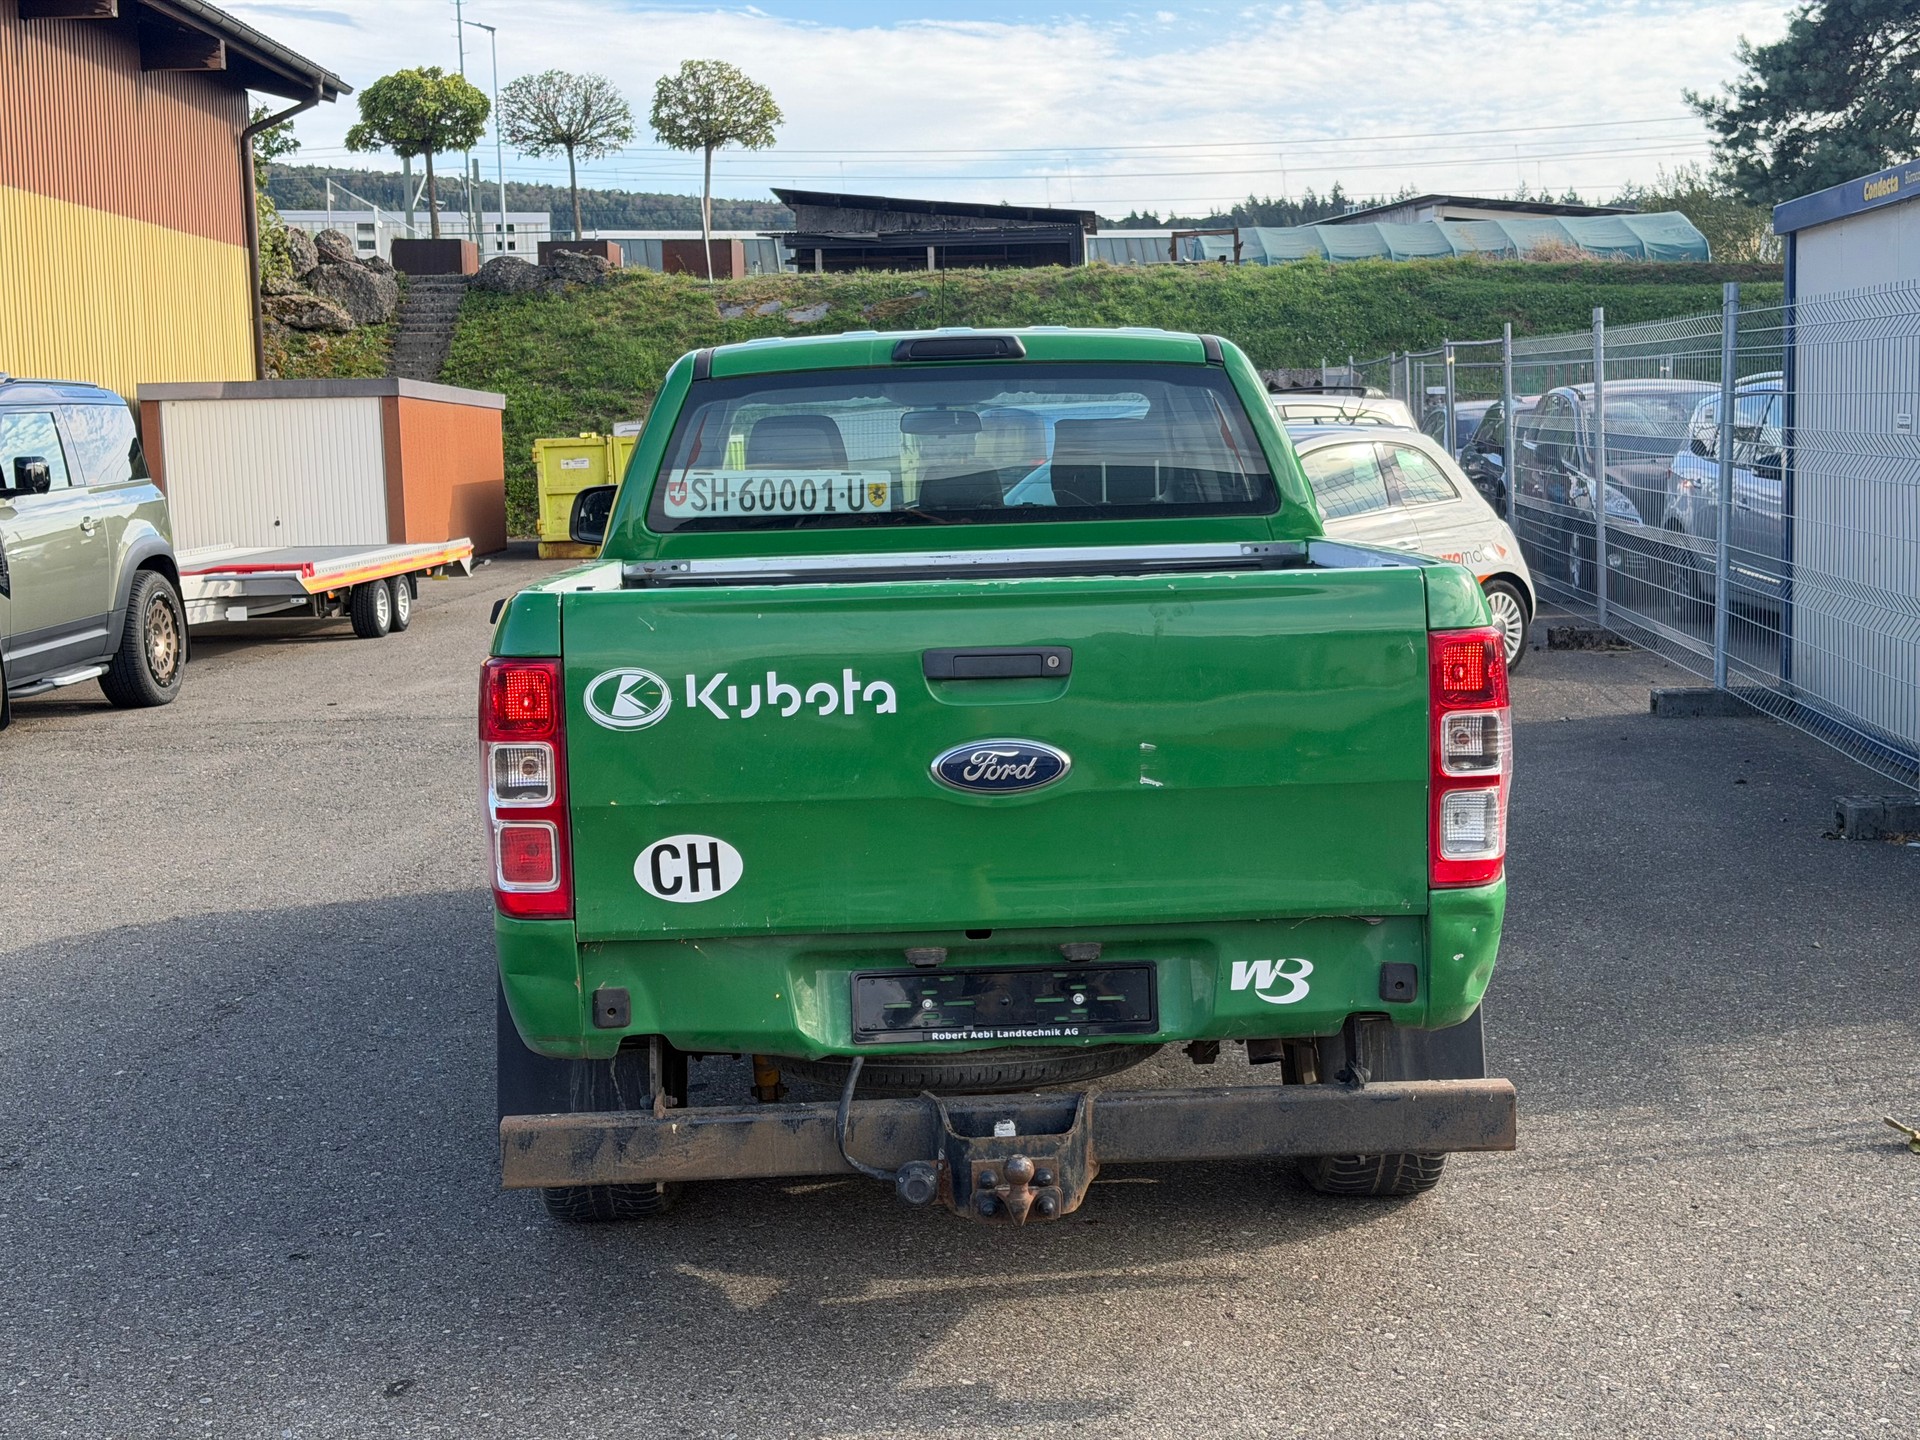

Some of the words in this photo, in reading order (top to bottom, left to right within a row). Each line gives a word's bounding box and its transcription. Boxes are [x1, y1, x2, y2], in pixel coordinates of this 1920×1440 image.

[1864, 174, 1899, 201] Condecta
[685, 668, 897, 720] Kubota
[963, 750, 1038, 781] Ford
[650, 842, 721, 896] CH
[931, 1031, 967, 1041] Robert
[970, 1029, 994, 1039] Aebi
[997, 1028, 1061, 1039] Landtechnik
[1064, 1027, 1079, 1036] AG
